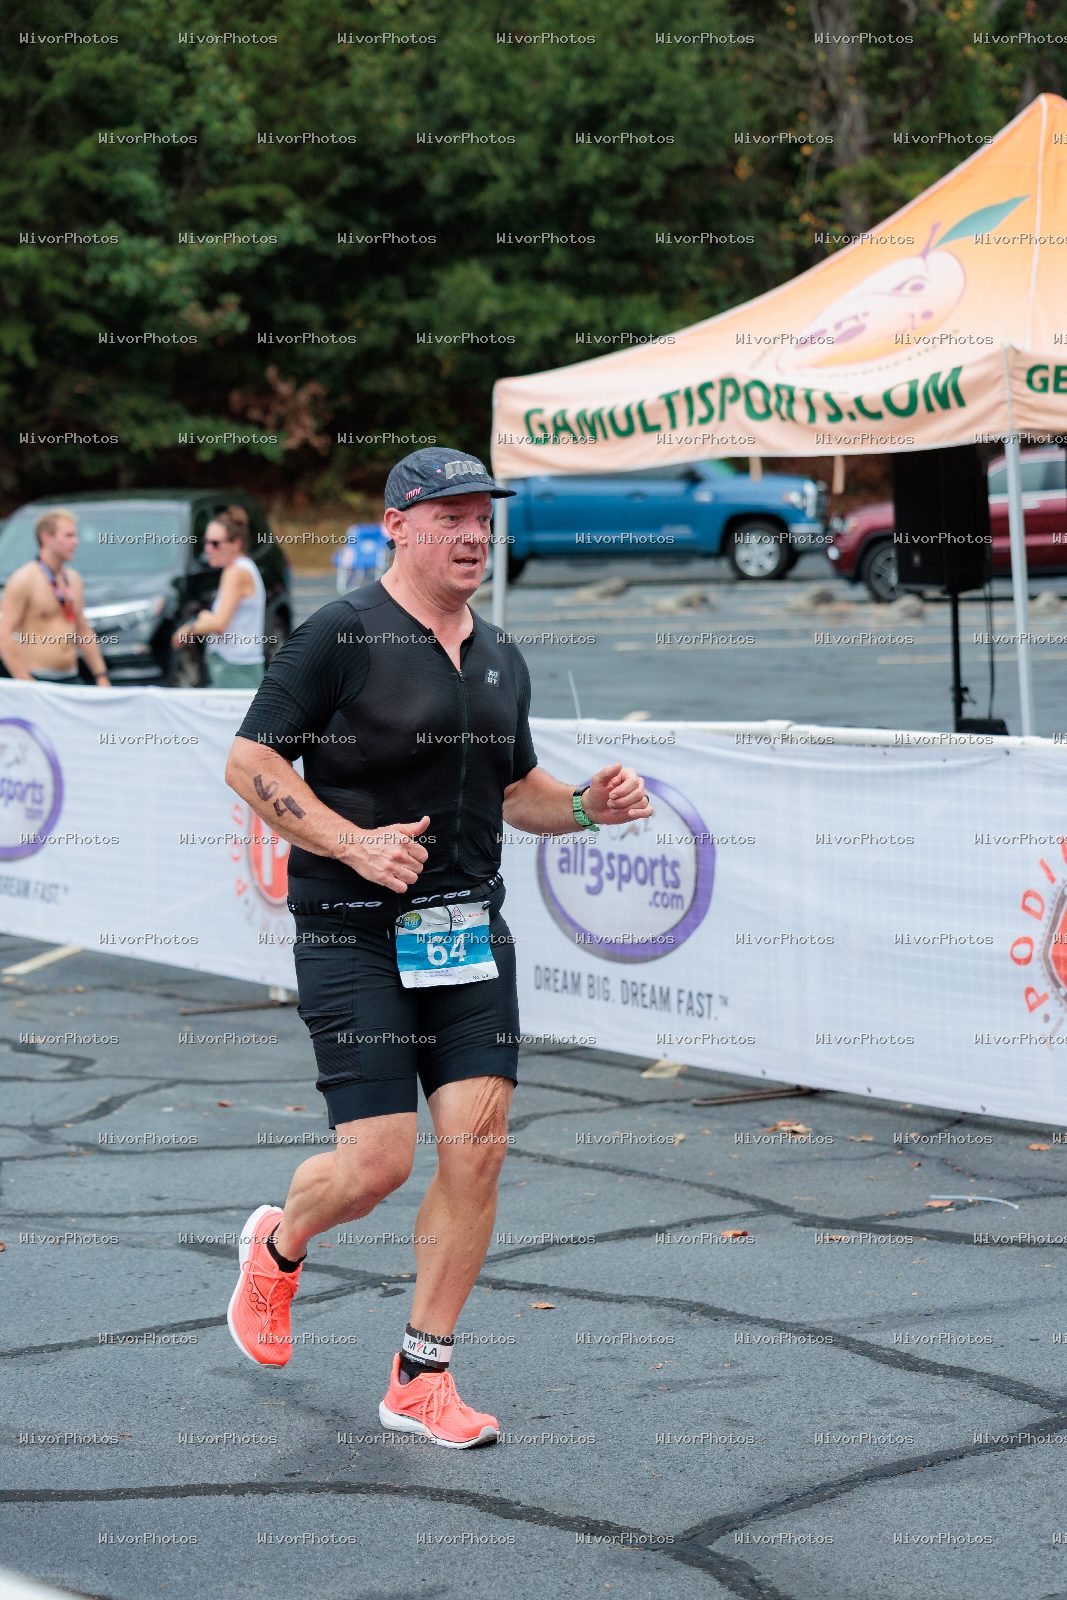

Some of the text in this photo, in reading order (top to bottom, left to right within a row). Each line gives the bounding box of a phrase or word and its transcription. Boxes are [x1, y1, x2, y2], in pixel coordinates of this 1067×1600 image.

[524, 365, 967, 445] GAMULTISPORTS.COM
[557, 845, 681, 895] all3sports
[649, 890, 684, 911] .com
[427, 933, 467, 967] 64
[534, 965, 581, 996] DREAM
[586, 974, 615, 1004] BIG.
[621, 979, 671, 1012] DREAM
